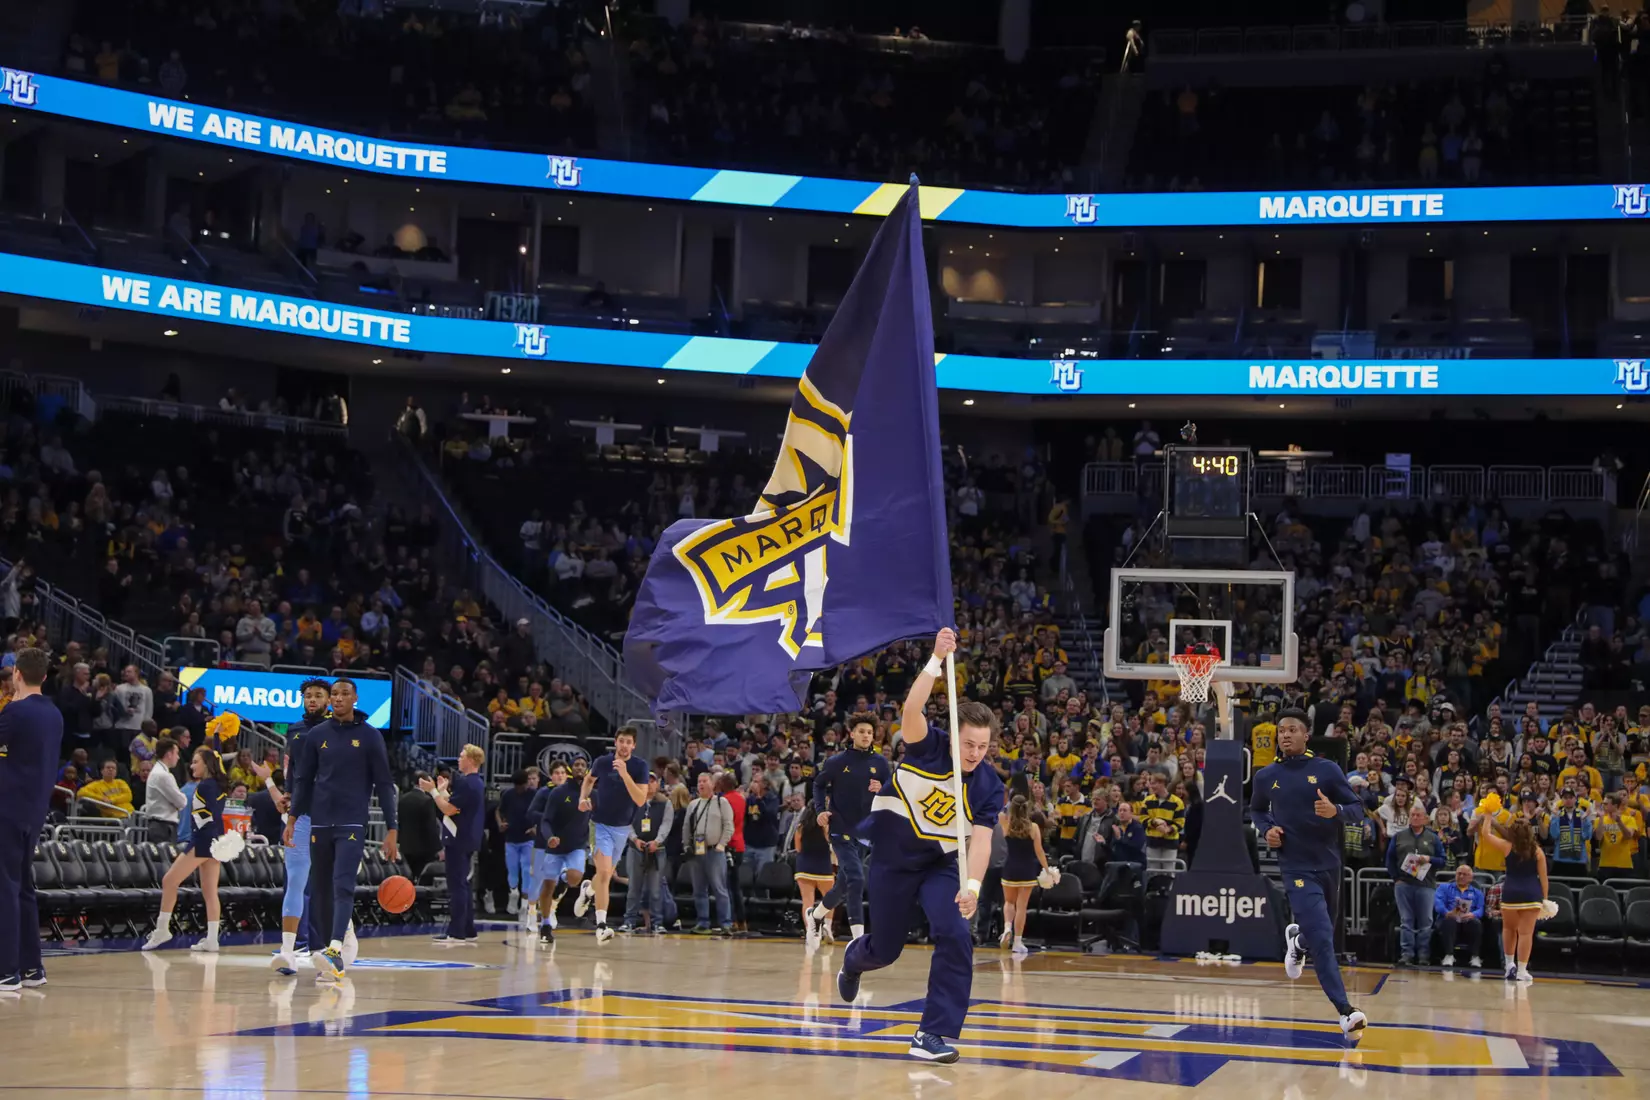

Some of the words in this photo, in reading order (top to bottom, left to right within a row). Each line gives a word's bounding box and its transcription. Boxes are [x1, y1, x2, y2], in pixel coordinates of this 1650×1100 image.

[1, 67, 39, 107] MU
[148, 101, 195, 133] WE
[201, 113, 262, 145] ARE
[269, 125, 447, 173] MARQUETTE
[546, 155, 582, 189] MU
[1064, 194, 1099, 225] MU
[1259, 193, 1444, 219] MARQUETTE
[1613, 184, 1650, 218] MU
[102, 274, 151, 306] WE
[158, 284, 222, 316] ARE
[230, 294, 411, 343] MARQUETTE
[513, 322, 549, 358] MU
[1049, 360, 1084, 393] MU
[1249, 365, 1439, 389] MARQUETTE
[1613, 359, 1650, 394] MU
[1193, 456, 1238, 475] 4:40
[720, 504, 827, 573] MARQ
[214, 685, 305, 709] MARQU
[918, 786, 957, 826] MU
[1176, 887, 1267, 924] meijer
